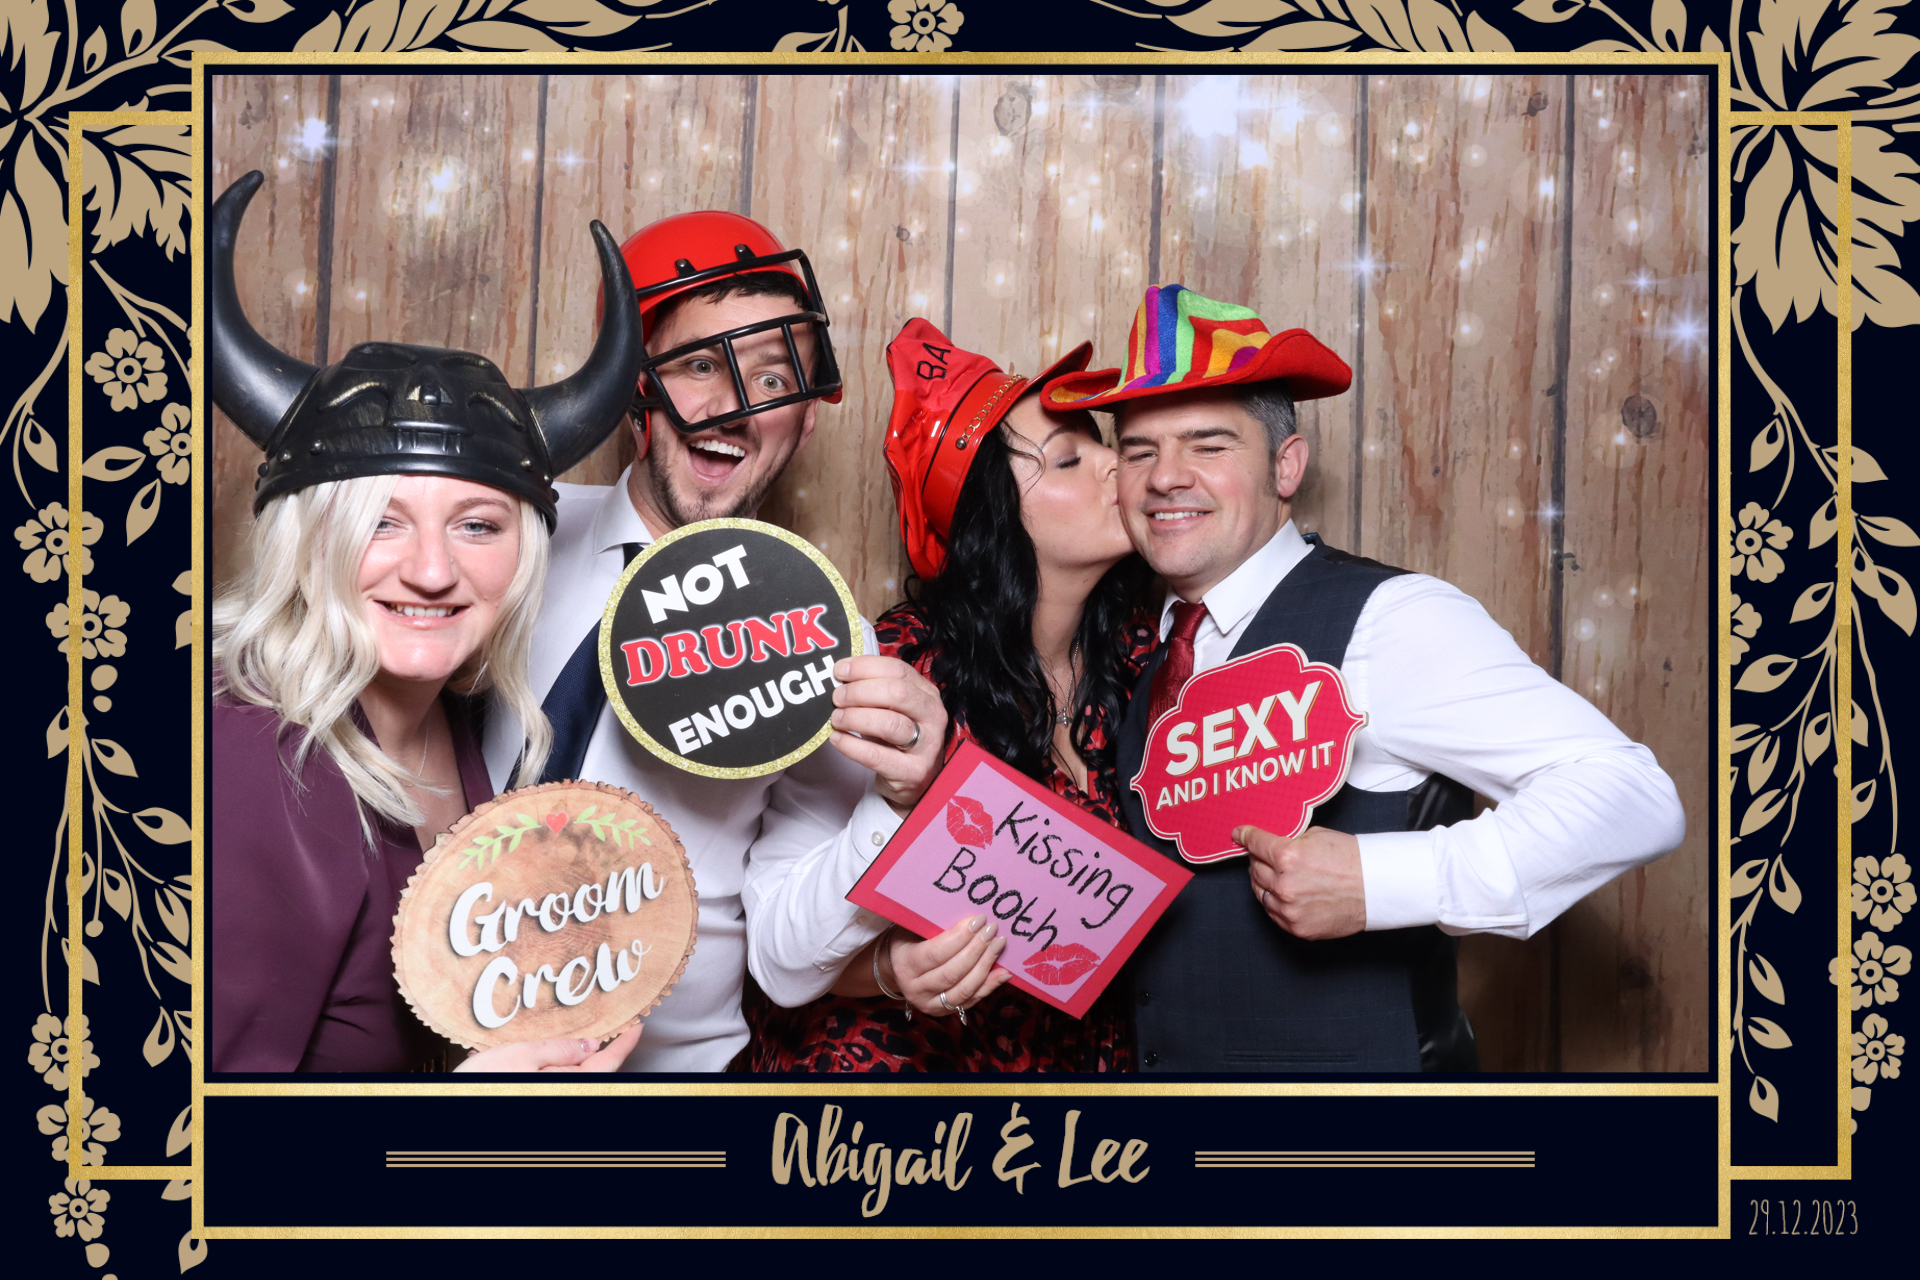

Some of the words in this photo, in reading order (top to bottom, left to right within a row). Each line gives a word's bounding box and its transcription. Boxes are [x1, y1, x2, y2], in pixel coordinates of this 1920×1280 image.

[641, 544, 750, 624] NOT
[620, 604, 839, 686] DRUNK
[668, 654, 844, 755] ENOUGH
[1165, 680, 1323, 776] SEXY
[1156, 777, 1207, 811] AND
[1213, 773, 1220, 796] I
[1225, 748, 1306, 792] KNOW
[1311, 741, 1336, 769] IT
[449, 862, 664, 957] Groom
[933, 847, 1058, 951] Booth
[995, 801, 1134, 930] Kissing
[472, 939, 652, 1028] Crew
